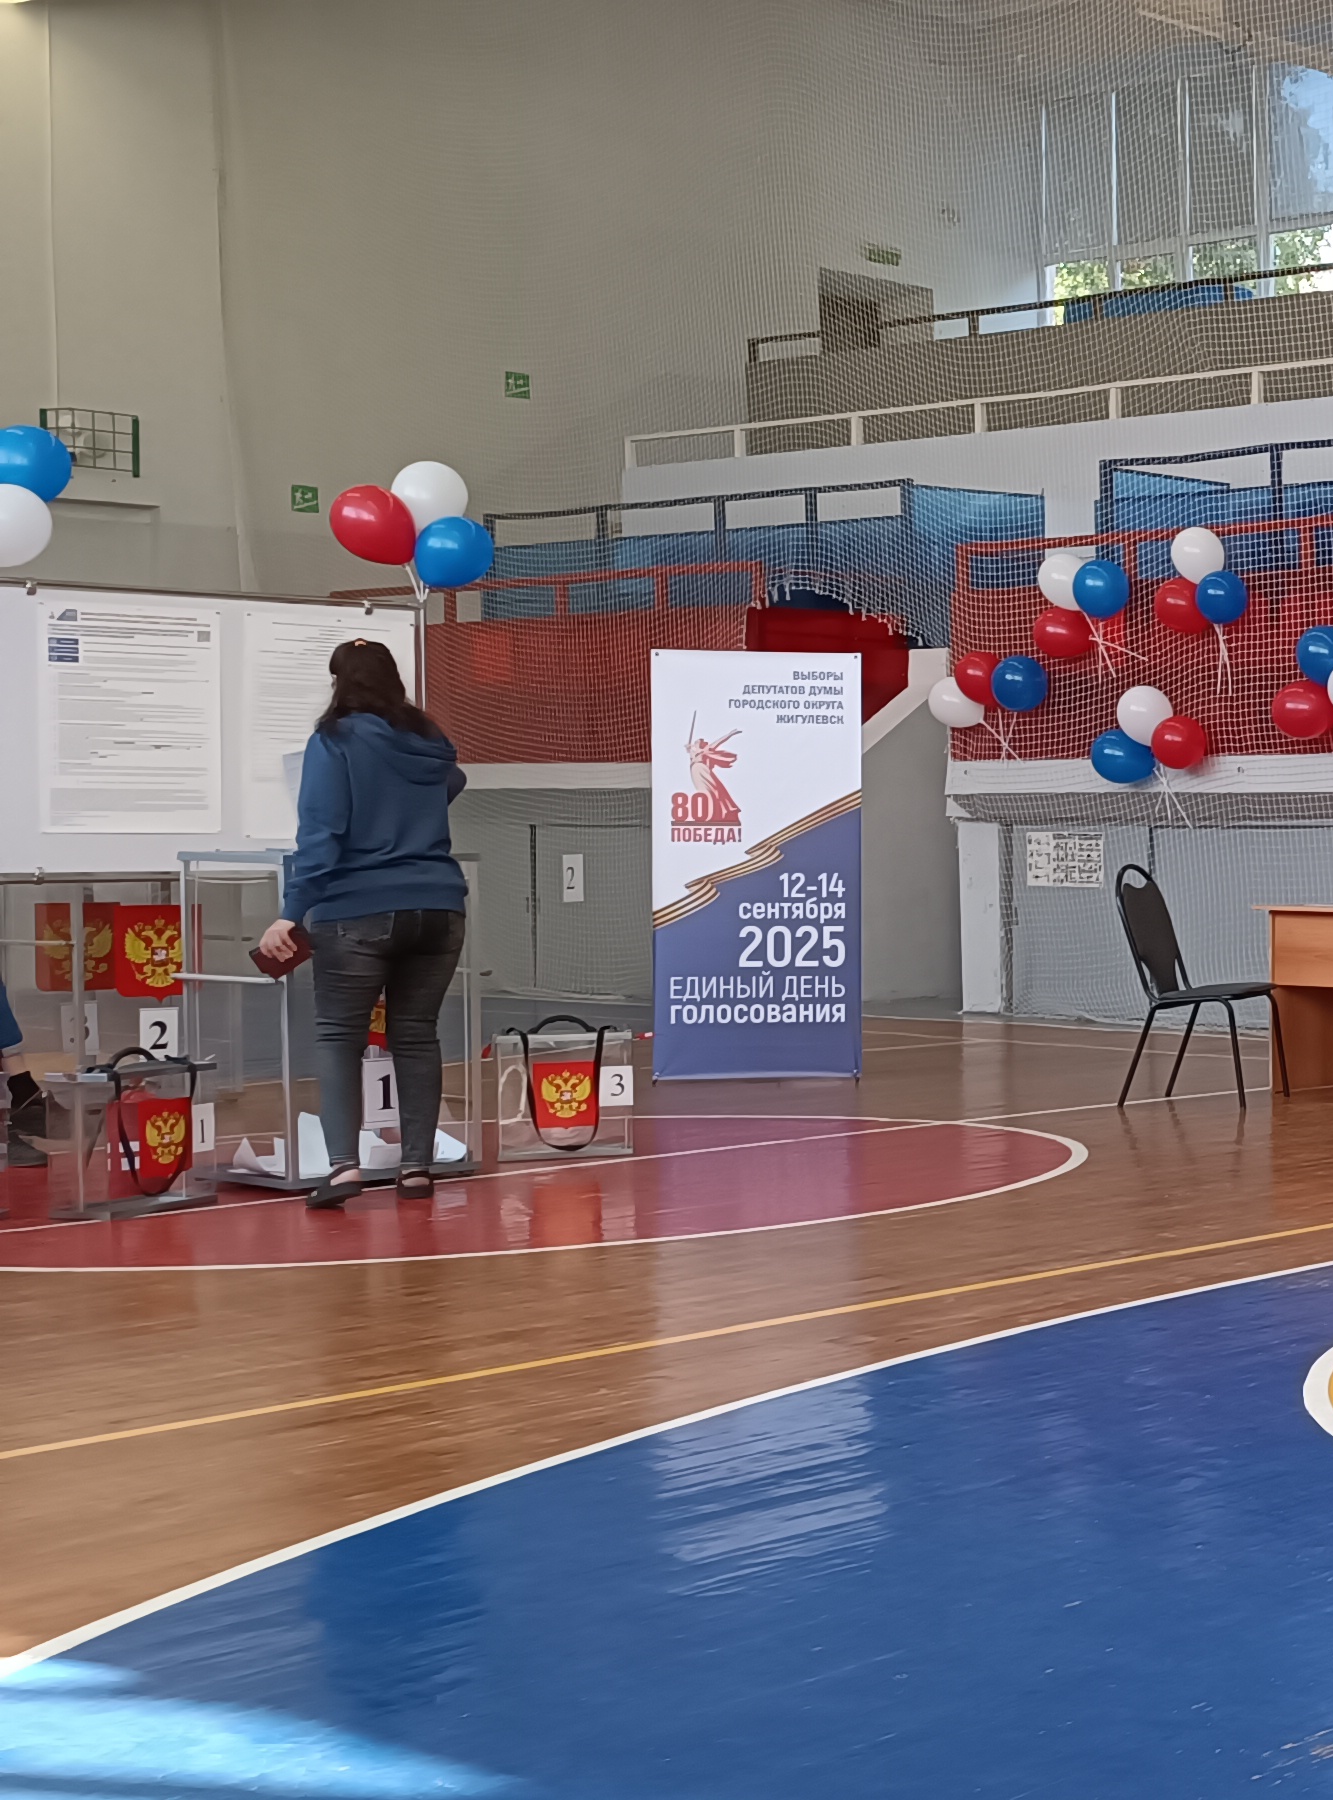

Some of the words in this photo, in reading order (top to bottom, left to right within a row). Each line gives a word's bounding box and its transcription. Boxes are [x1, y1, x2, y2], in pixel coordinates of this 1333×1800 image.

[792, 671, 844, 681] ВЫБОРЫ
[742, 684, 806, 696] ДЕПУТАТОВ
[808, 685, 844, 697] ДУМЫ
[728, 698, 801, 710] ГОРОДСКОГО
[803, 700, 844, 711] ОКРУГА
[776, 714, 845, 725] ЖИГУЛЕВСК
[671, 792, 710, 823] 80
[671, 827, 742, 845] ПОБЕДА!
[565, 866, 576, 890] 2
[779, 872, 846, 898] 12-14
[738, 897, 846, 924] сентября
[738, 925, 846, 968] 2025
[669, 970, 775, 1002] ЕДИНЫЙ
[781, 975, 846, 1002] ДЕНЬ
[669, 1003, 846, 1025] голосования
[149, 1020, 169, 1050] 2
[376, 1073, 395, 1111] 1
[610, 1073, 625, 1097] 3
